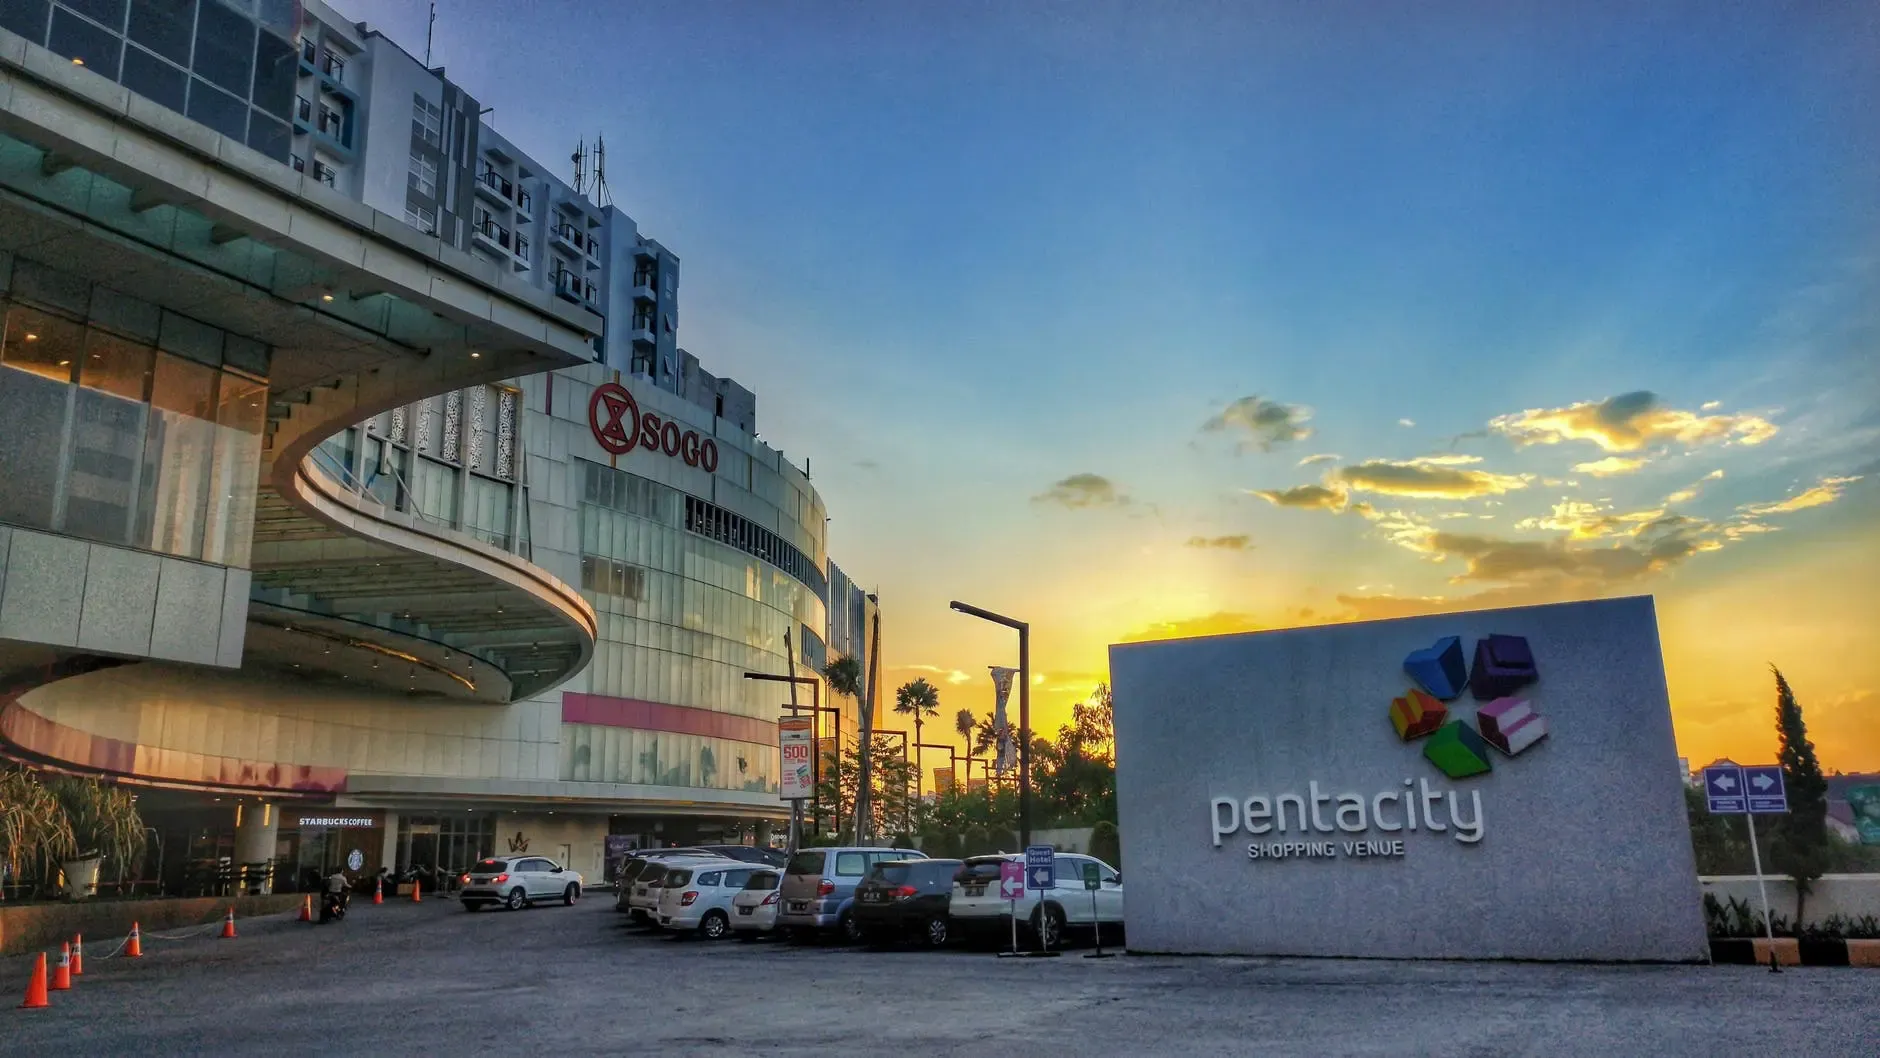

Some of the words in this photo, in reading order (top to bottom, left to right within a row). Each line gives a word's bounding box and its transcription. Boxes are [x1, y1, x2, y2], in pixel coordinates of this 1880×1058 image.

[640, 412, 719, 473] SOGO
[784, 745, 808, 759] 500
[1210, 777, 1485, 847] pentacity
[299, 817, 349, 826] STARBUCKS
[348, 818, 373, 826] COFFEE
[1247, 841, 1336, 859] SHOPPING
[1343, 840, 1405, 857] VENUE
[1029, 856, 1052, 864] Hotel
